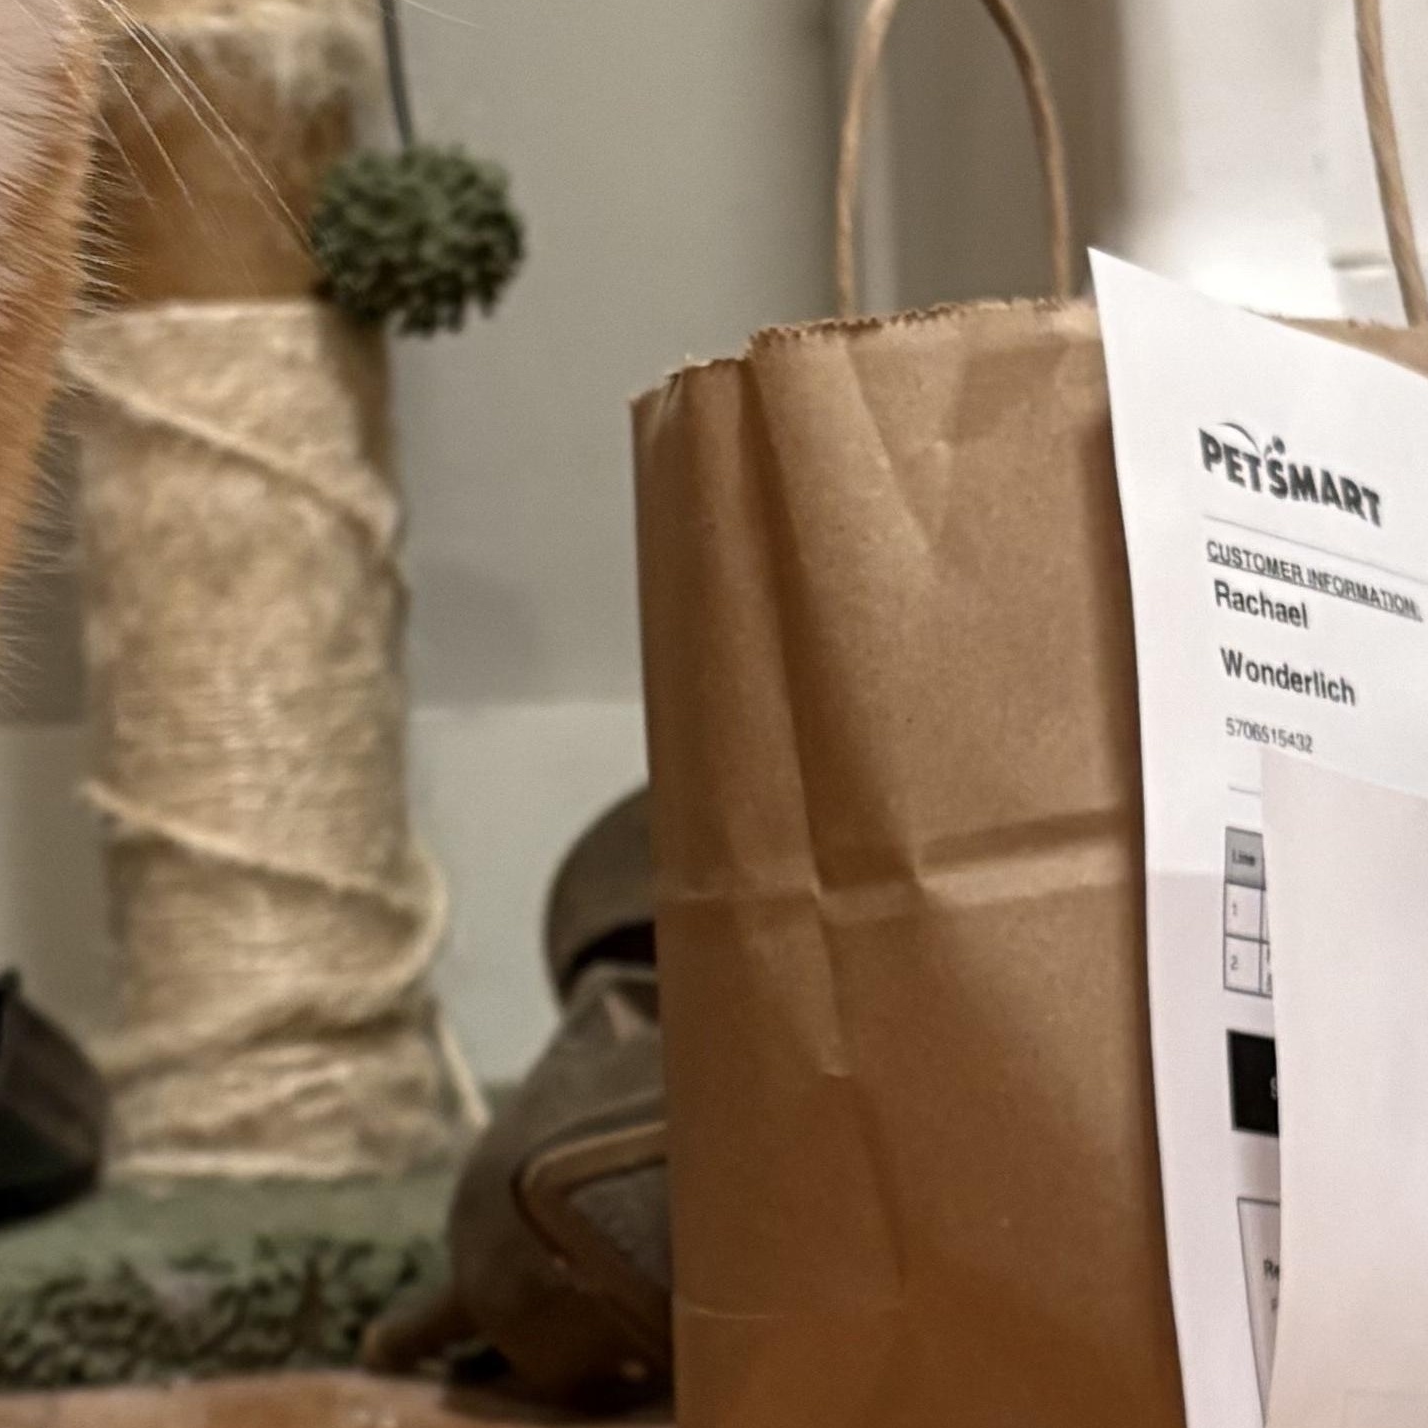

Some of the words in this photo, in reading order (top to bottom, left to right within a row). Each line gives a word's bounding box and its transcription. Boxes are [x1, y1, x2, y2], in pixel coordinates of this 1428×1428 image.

[1198, 426, 1383, 528] PETSMART
[1206, 540, 1306, 586] CUSTOMER
[1213, 578, 1310, 630] Rachael
[1220, 646, 1357, 707] Wonderlich
[1230, 954, 1239, 971] 2
